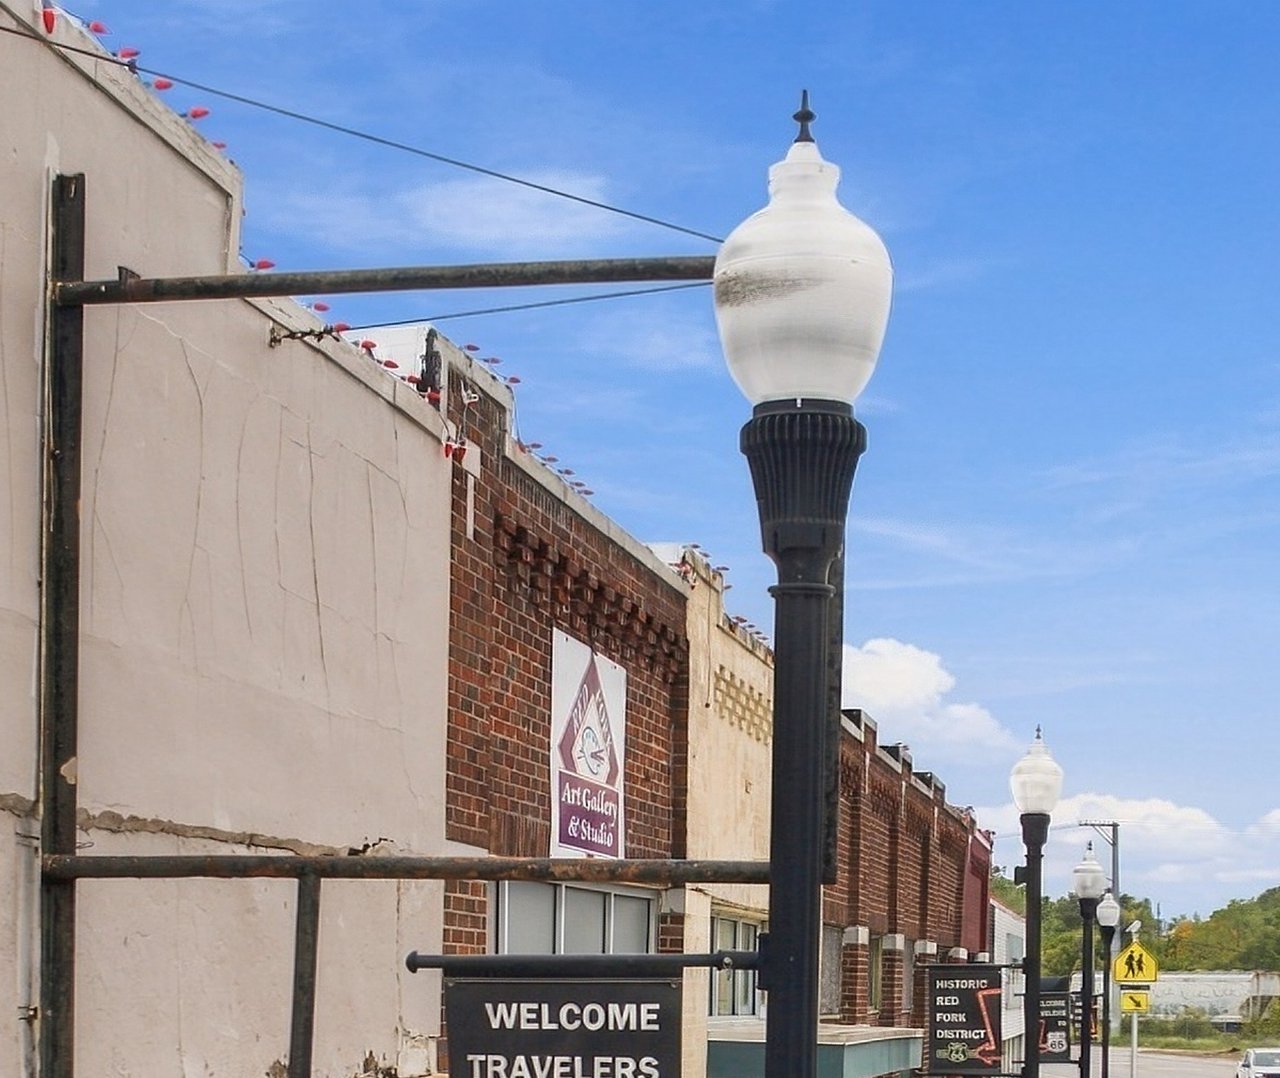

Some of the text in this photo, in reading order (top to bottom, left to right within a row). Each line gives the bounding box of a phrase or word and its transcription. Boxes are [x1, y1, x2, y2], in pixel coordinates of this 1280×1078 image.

[561, 782, 618, 827] Art Gallery
[568, 815, 613, 848] & Studio
[936, 979, 988, 989] HISTORIC
[936, 996, 960, 1006] RED
[484, 1002, 660, 1031] WELCOME
[936, 1013, 967, 1022] FORK
[936, 1029, 986, 1039] DISTRICT
[1050, 1040, 1065, 1050] 66
[951, 1049, 965, 1059] 66
